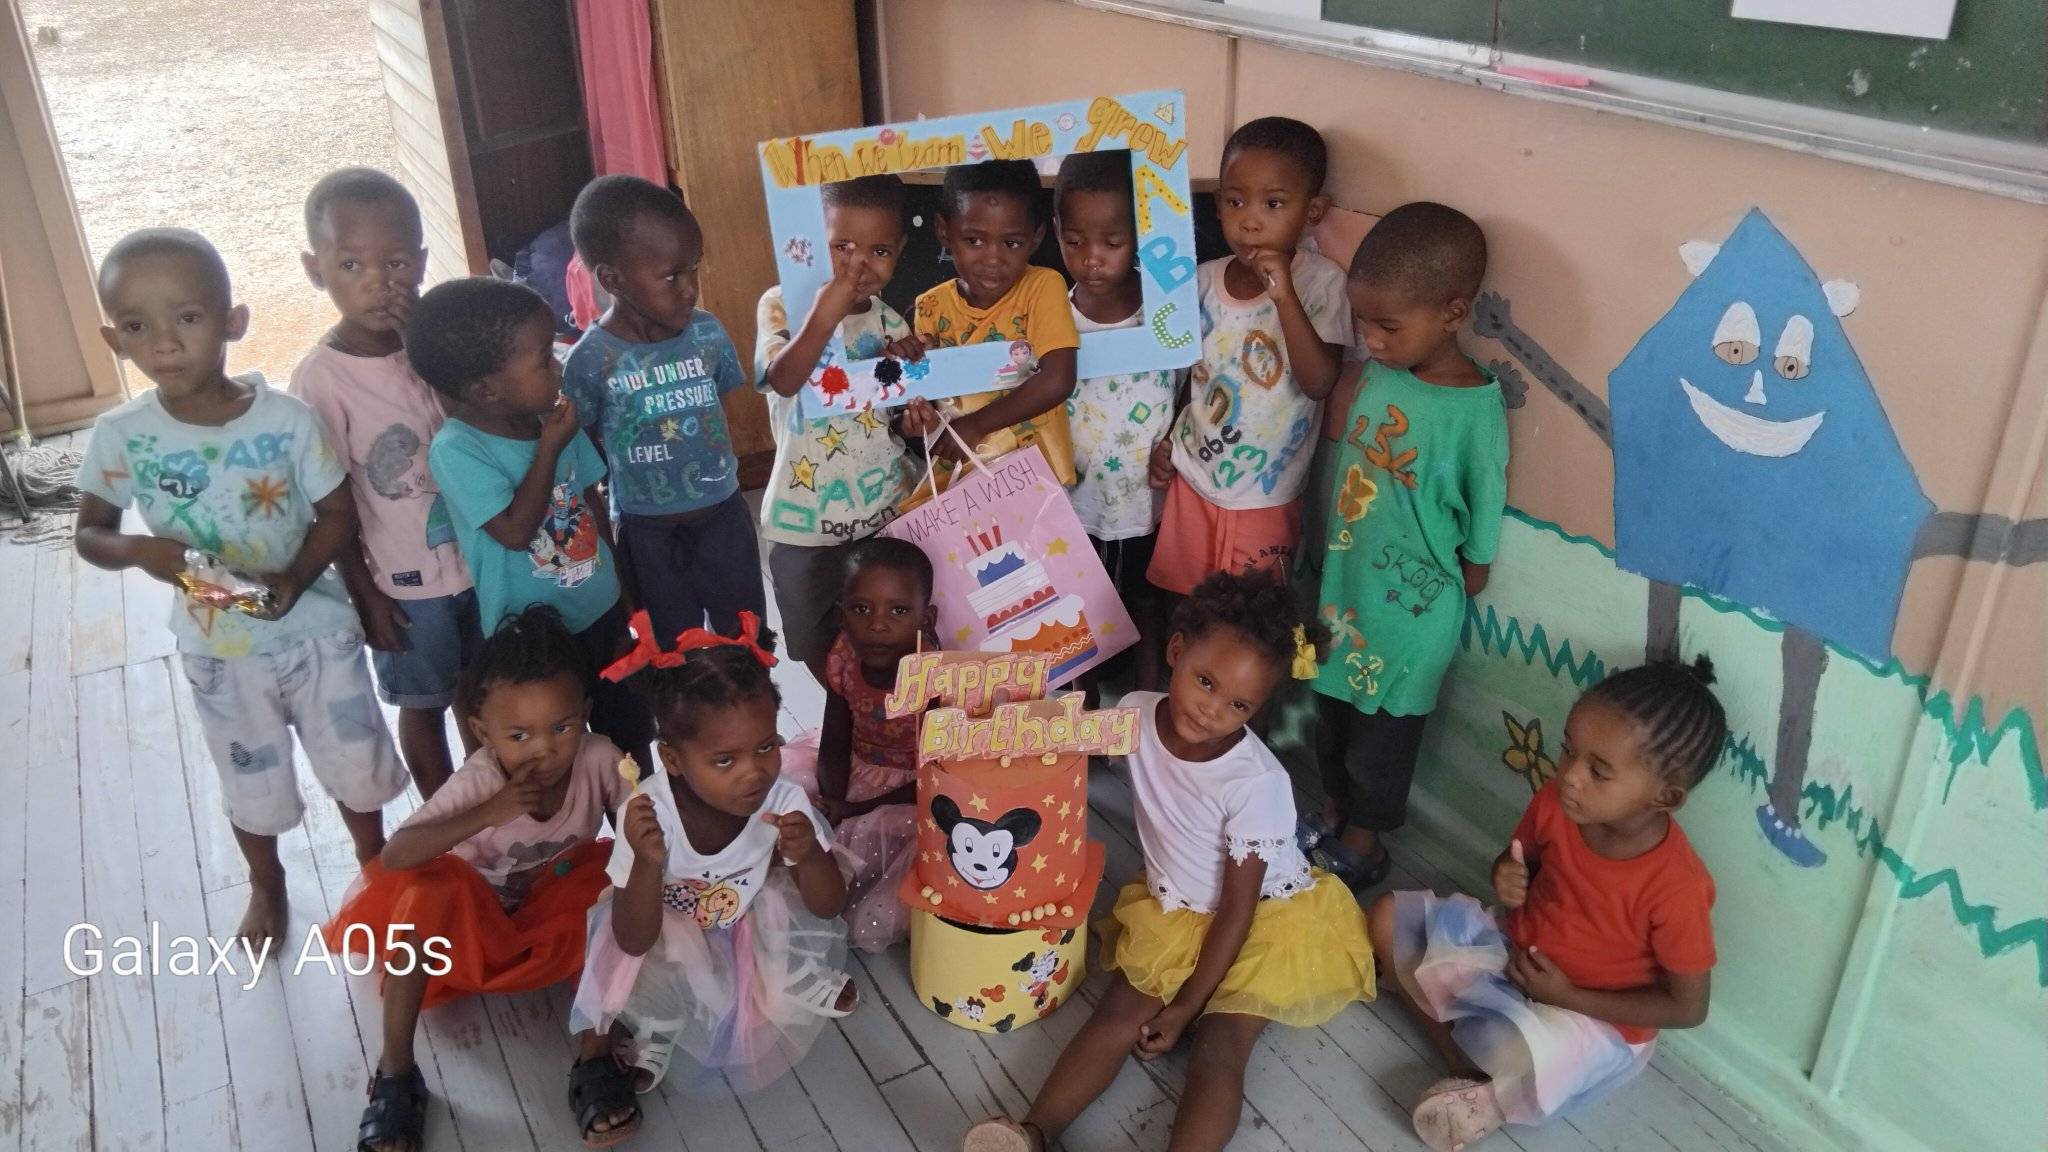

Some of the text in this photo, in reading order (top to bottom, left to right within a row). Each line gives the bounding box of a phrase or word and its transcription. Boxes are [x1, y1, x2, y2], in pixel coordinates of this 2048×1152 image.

[653, 358, 706, 385] UNDER
[628, 444, 674, 463] LEVEL
[1211, 444, 1268, 489] 123
[906, 457, 1039, 544] MAKE A WISH
[887, 653, 1048, 717] Happy
[922, 695, 1136, 756] Birthday
